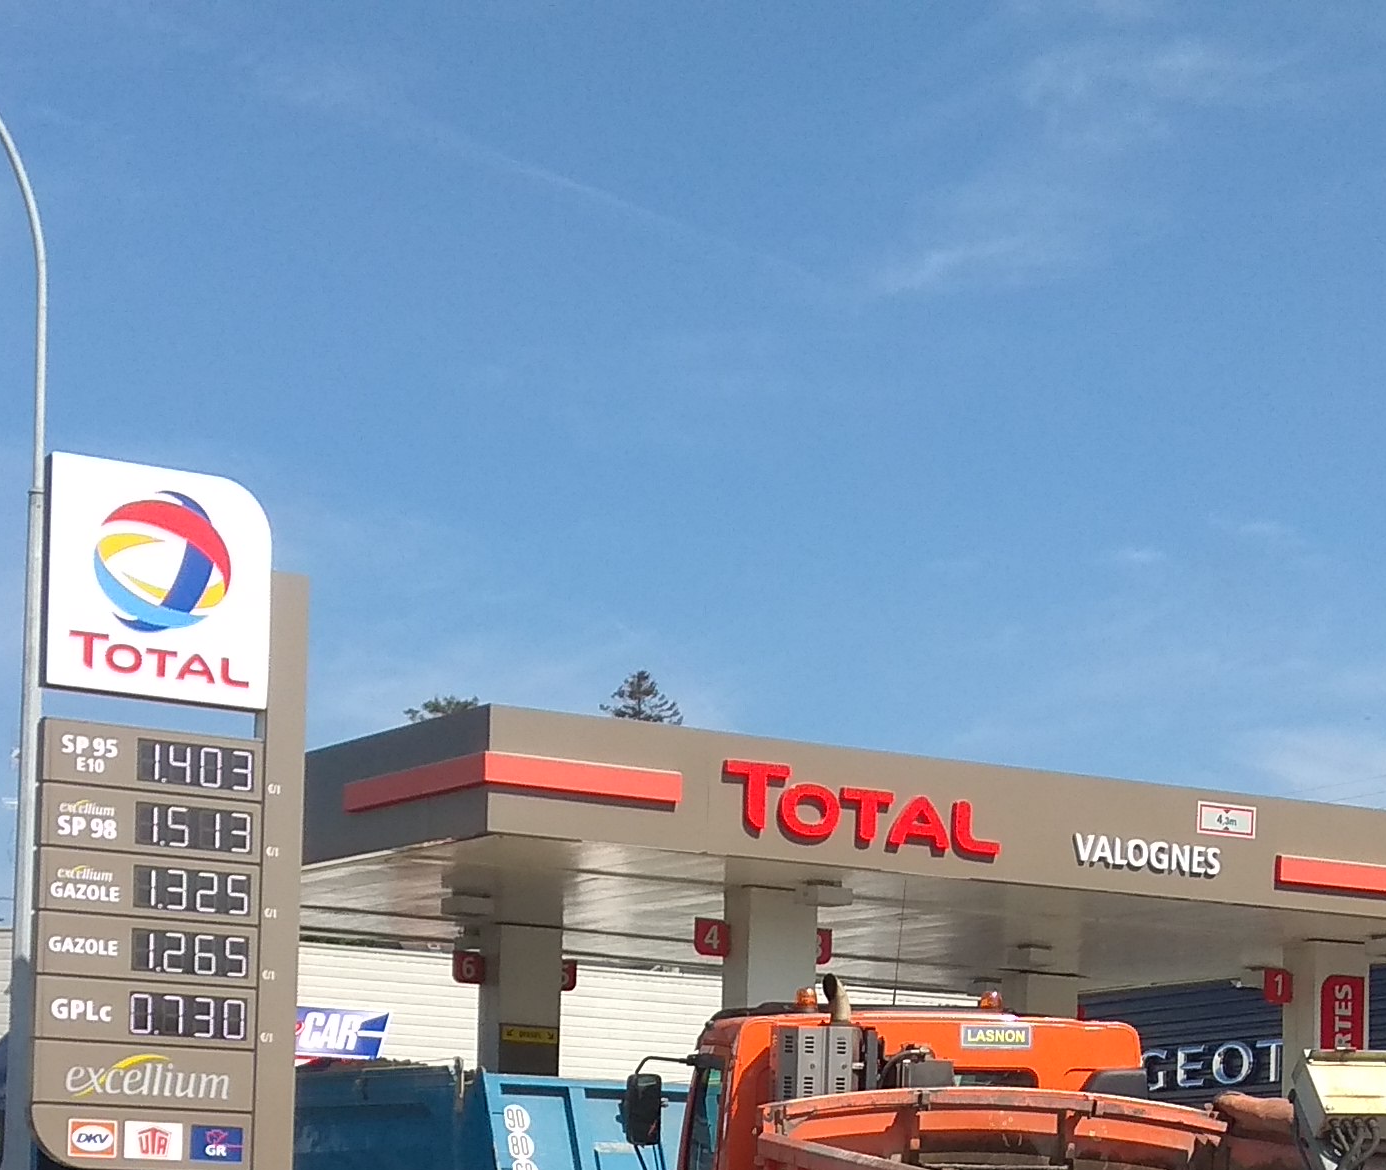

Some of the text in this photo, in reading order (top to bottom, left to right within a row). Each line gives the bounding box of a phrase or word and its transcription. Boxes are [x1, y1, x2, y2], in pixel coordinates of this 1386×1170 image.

[69, 630, 250, 689] TOTAL
[61, 734, 89, 756] SP
[93, 738, 118, 758] 95
[76, 757, 105, 773] E10
[59, 802, 115, 817] excellium
[723, 758, 1001, 859] TOTAL
[57, 815, 86, 836] SP
[90, 818, 117, 840] 98
[1074, 832, 1221, 877] VALOGNES
[57, 866, 113, 883] excellium
[50, 881, 120, 903] GAZOLE
[48, 936, 118, 957] GAZOLE
[704, 923, 720, 950] 4
[461, 958, 475, 978] 6
[1274, 974, 1283, 997] 1
[51, 998, 112, 1022] GPLc
[1335, 984, 1353, 1049] RTES
[967, 1029, 1026, 1043] LASNON
[1142, 1038, 1283, 1092] GEOT
[65, 1063, 230, 1100] excellium
[506, 1108, 525, 1129] 90
[75, 1132, 110, 1144] DKV
[138, 1127, 172, 1158] UTA
[510, 1135, 529, 1156] 80
[205, 1144, 228, 1157] GR
